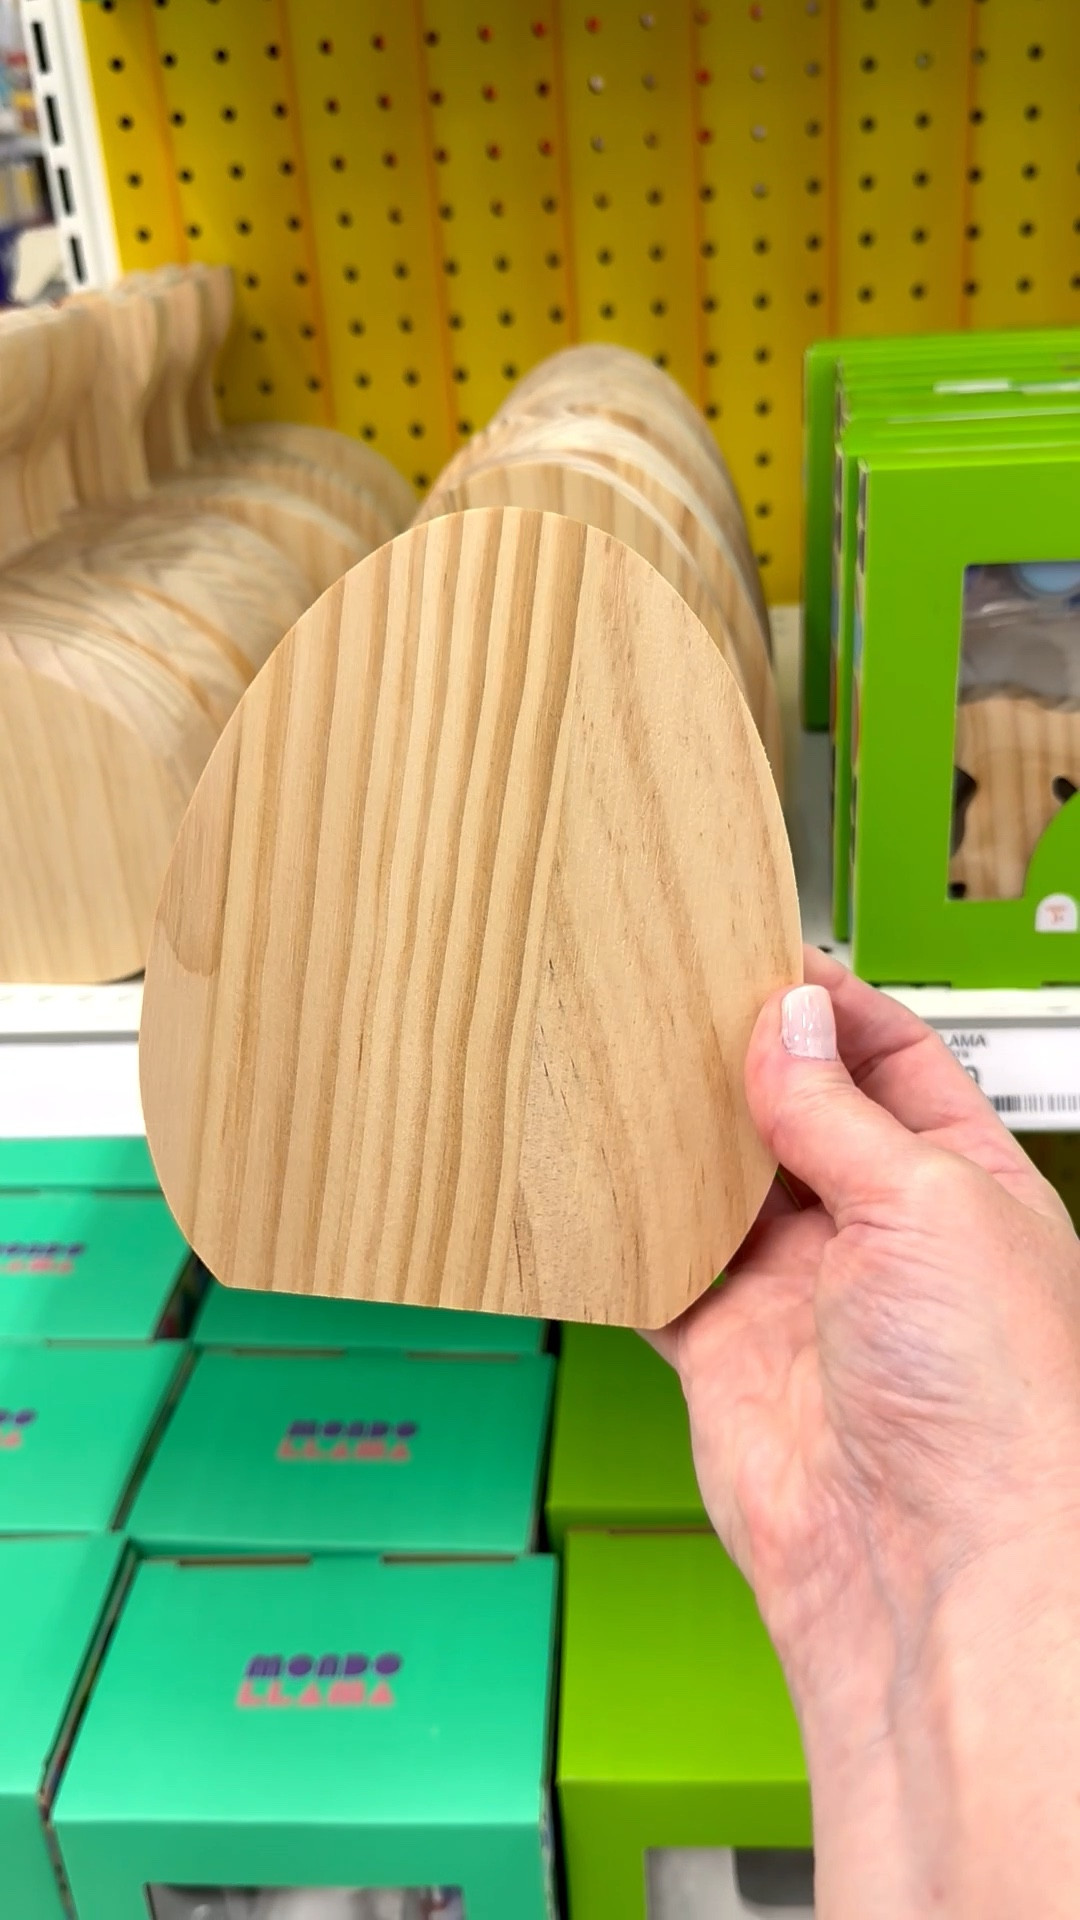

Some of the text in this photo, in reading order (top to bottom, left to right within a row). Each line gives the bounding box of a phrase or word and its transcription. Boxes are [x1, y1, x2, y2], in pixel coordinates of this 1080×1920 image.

[943, 1033, 987, 1047] AMA
[246, 1652, 403, 1679] MONDO
[236, 1679, 396, 1707] LLAMA
